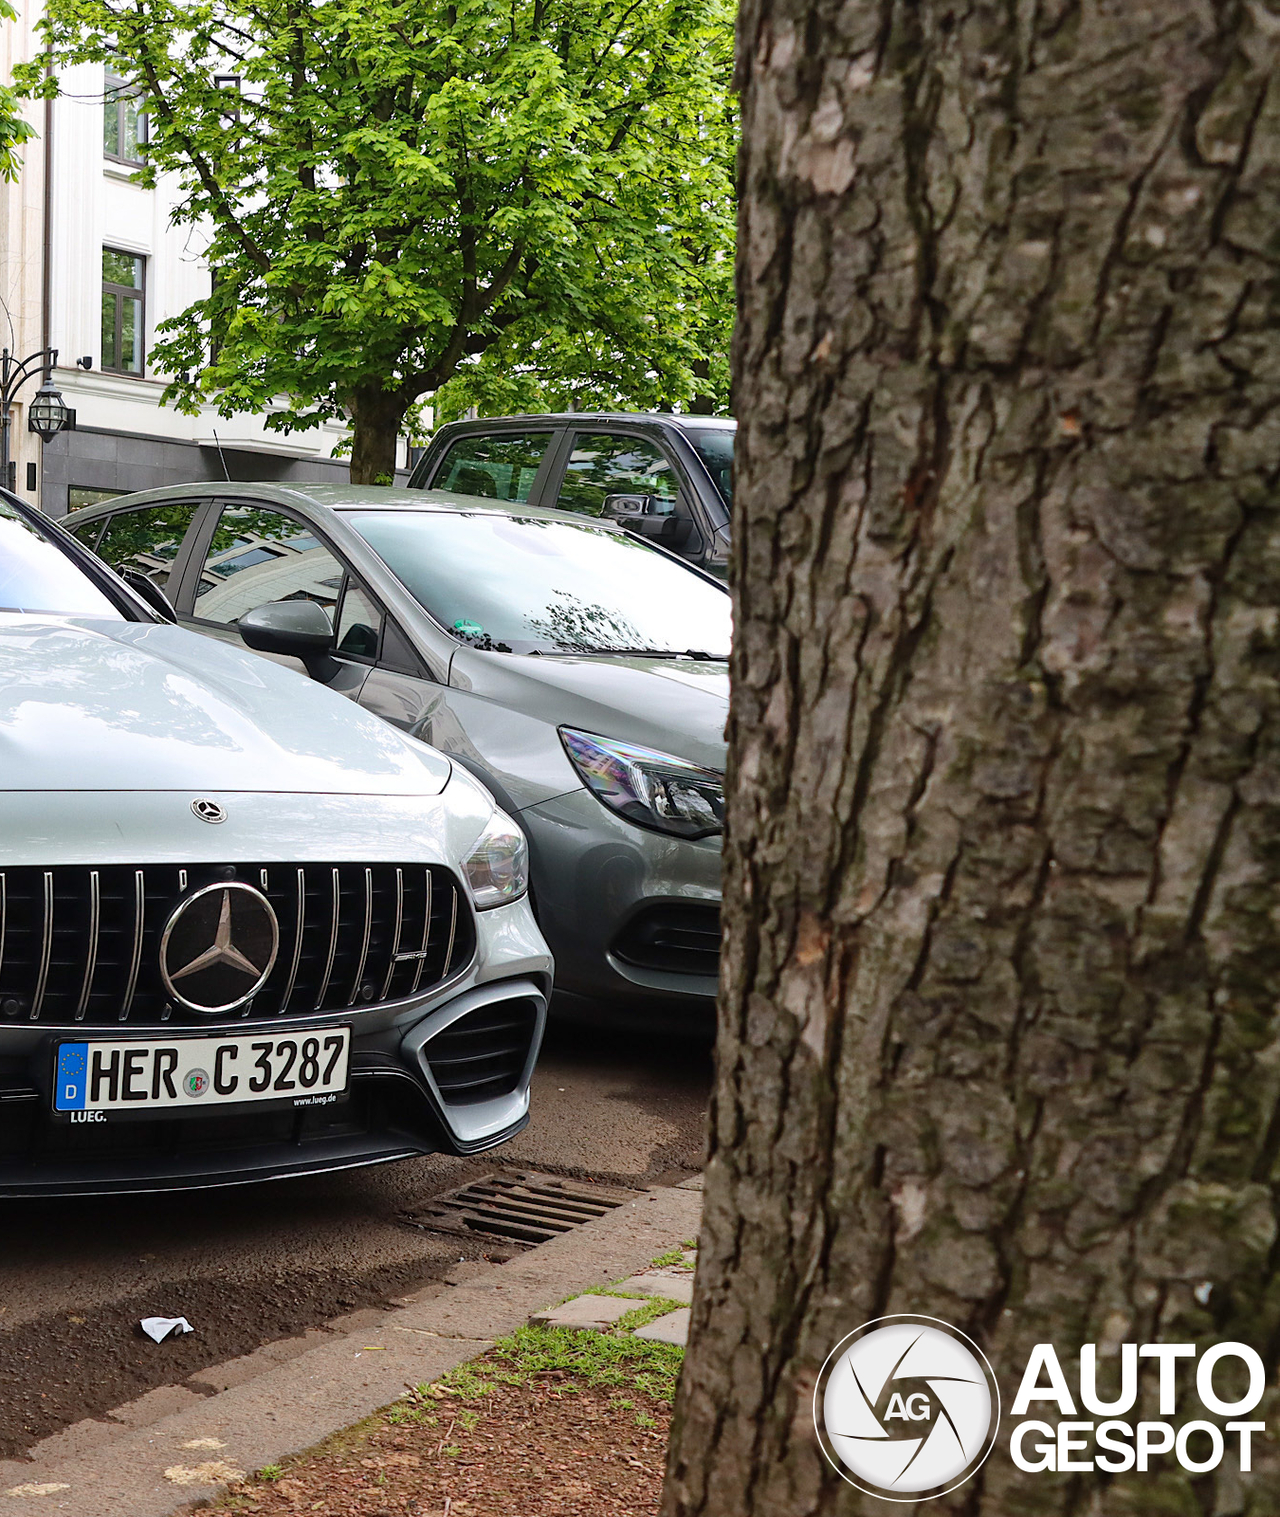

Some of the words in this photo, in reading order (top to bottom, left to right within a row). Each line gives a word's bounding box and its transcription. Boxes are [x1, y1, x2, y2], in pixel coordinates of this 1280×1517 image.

[90, 1048, 179, 1102] HER
[213, 1044, 239, 1096] C
[248, 1035, 345, 1093] 3287
[64, 1084, 78, 1100] D
[293, 1093, 337, 1107] www.lueg.de
[70, 1110, 108, 1124] LUEG.
